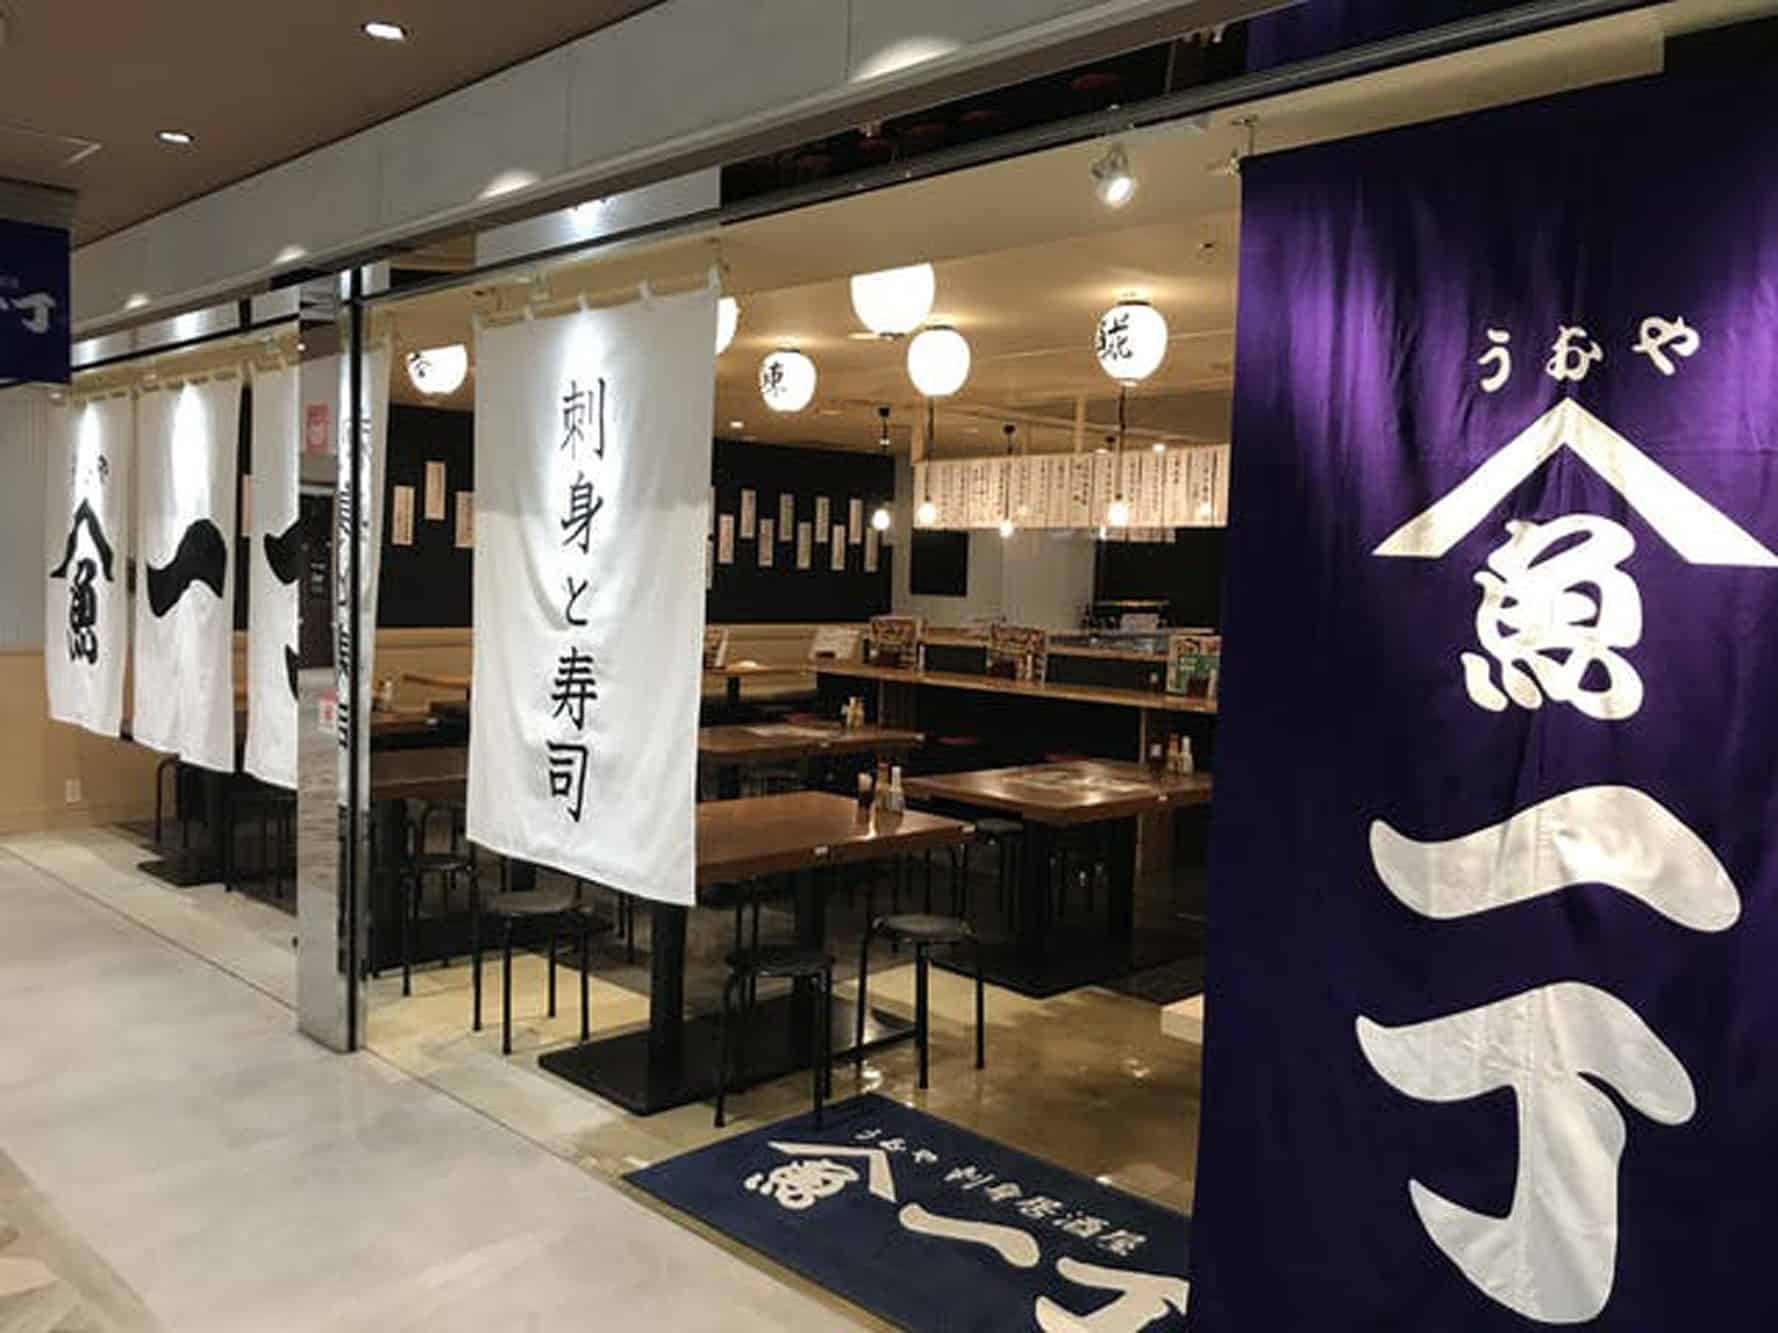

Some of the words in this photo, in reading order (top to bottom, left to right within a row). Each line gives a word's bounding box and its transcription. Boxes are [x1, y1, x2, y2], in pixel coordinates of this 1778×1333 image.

[548, 377, 606, 823] 刺身と寿司
